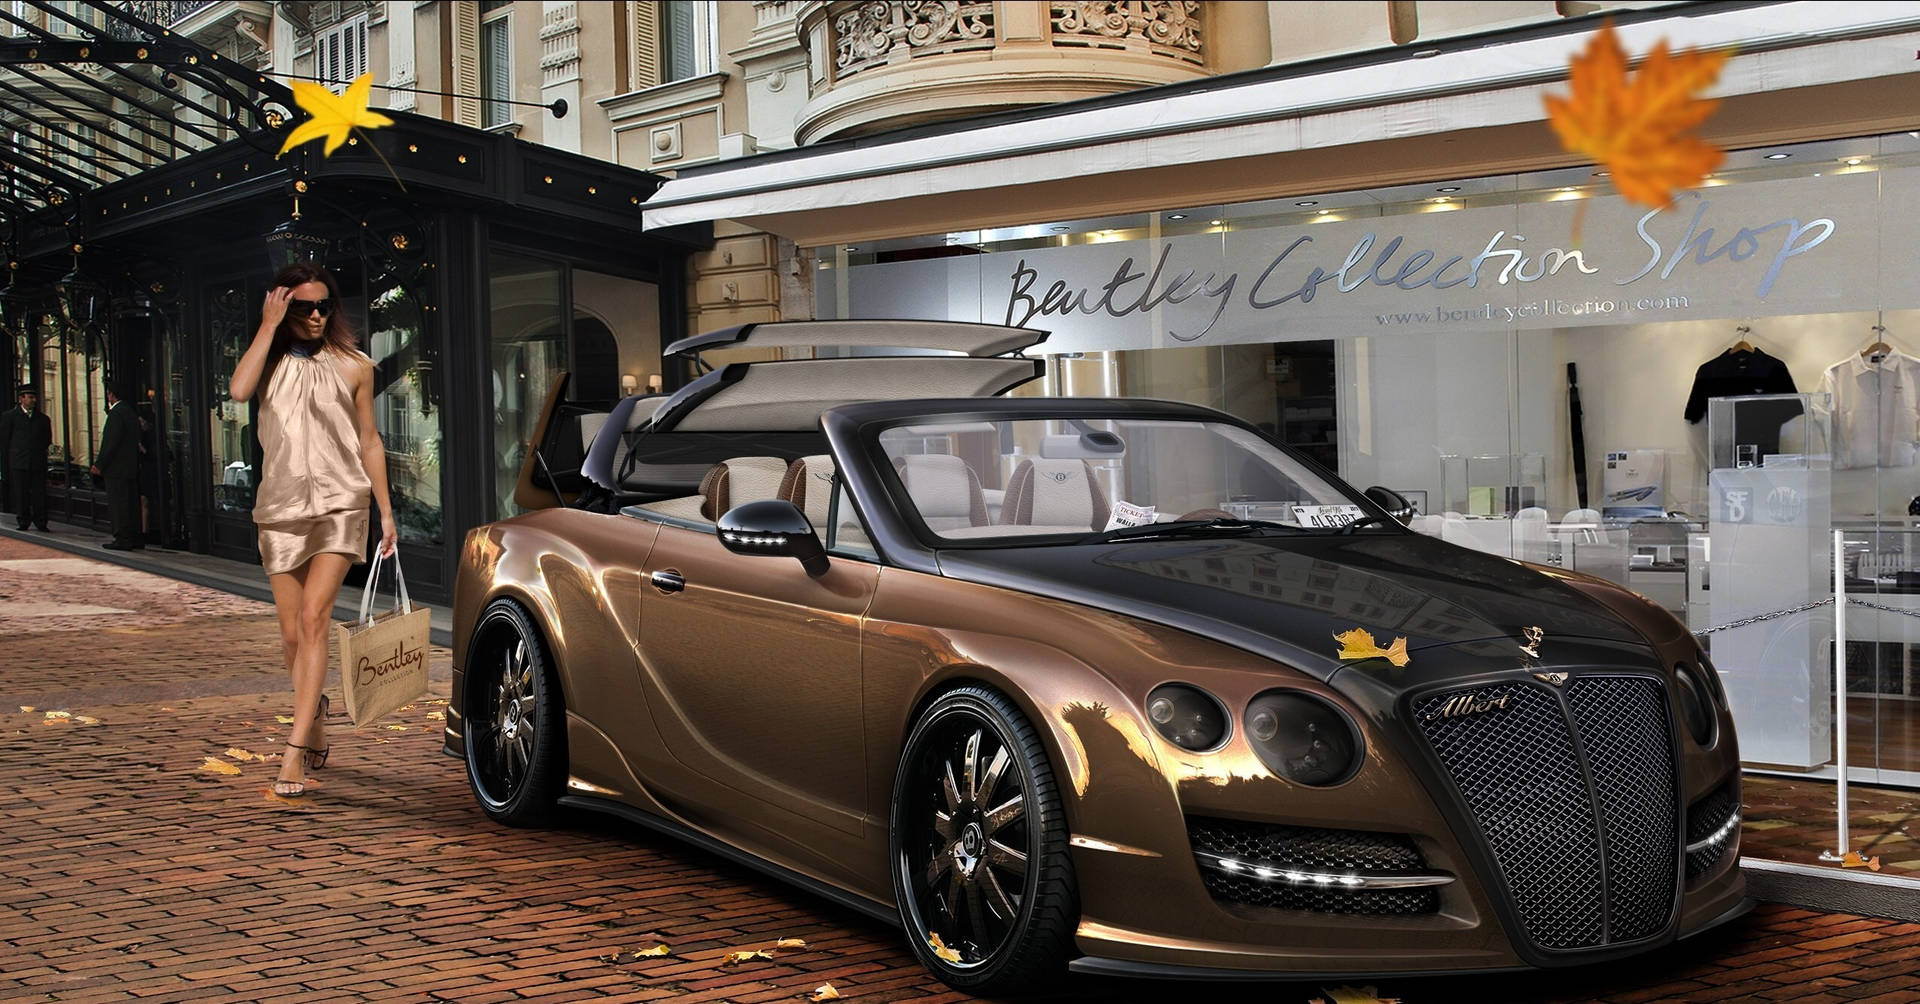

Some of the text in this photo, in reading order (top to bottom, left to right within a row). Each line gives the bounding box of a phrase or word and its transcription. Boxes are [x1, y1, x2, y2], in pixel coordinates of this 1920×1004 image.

[1006, 198, 1836, 342] Bentley Collection Shop
[1120, 506, 1145, 518] TICKET
[1310, 513, 1358, 528] 4LB3RT
[353, 640, 424, 688] Bentley
[1426, 694, 1512, 721] Albert
